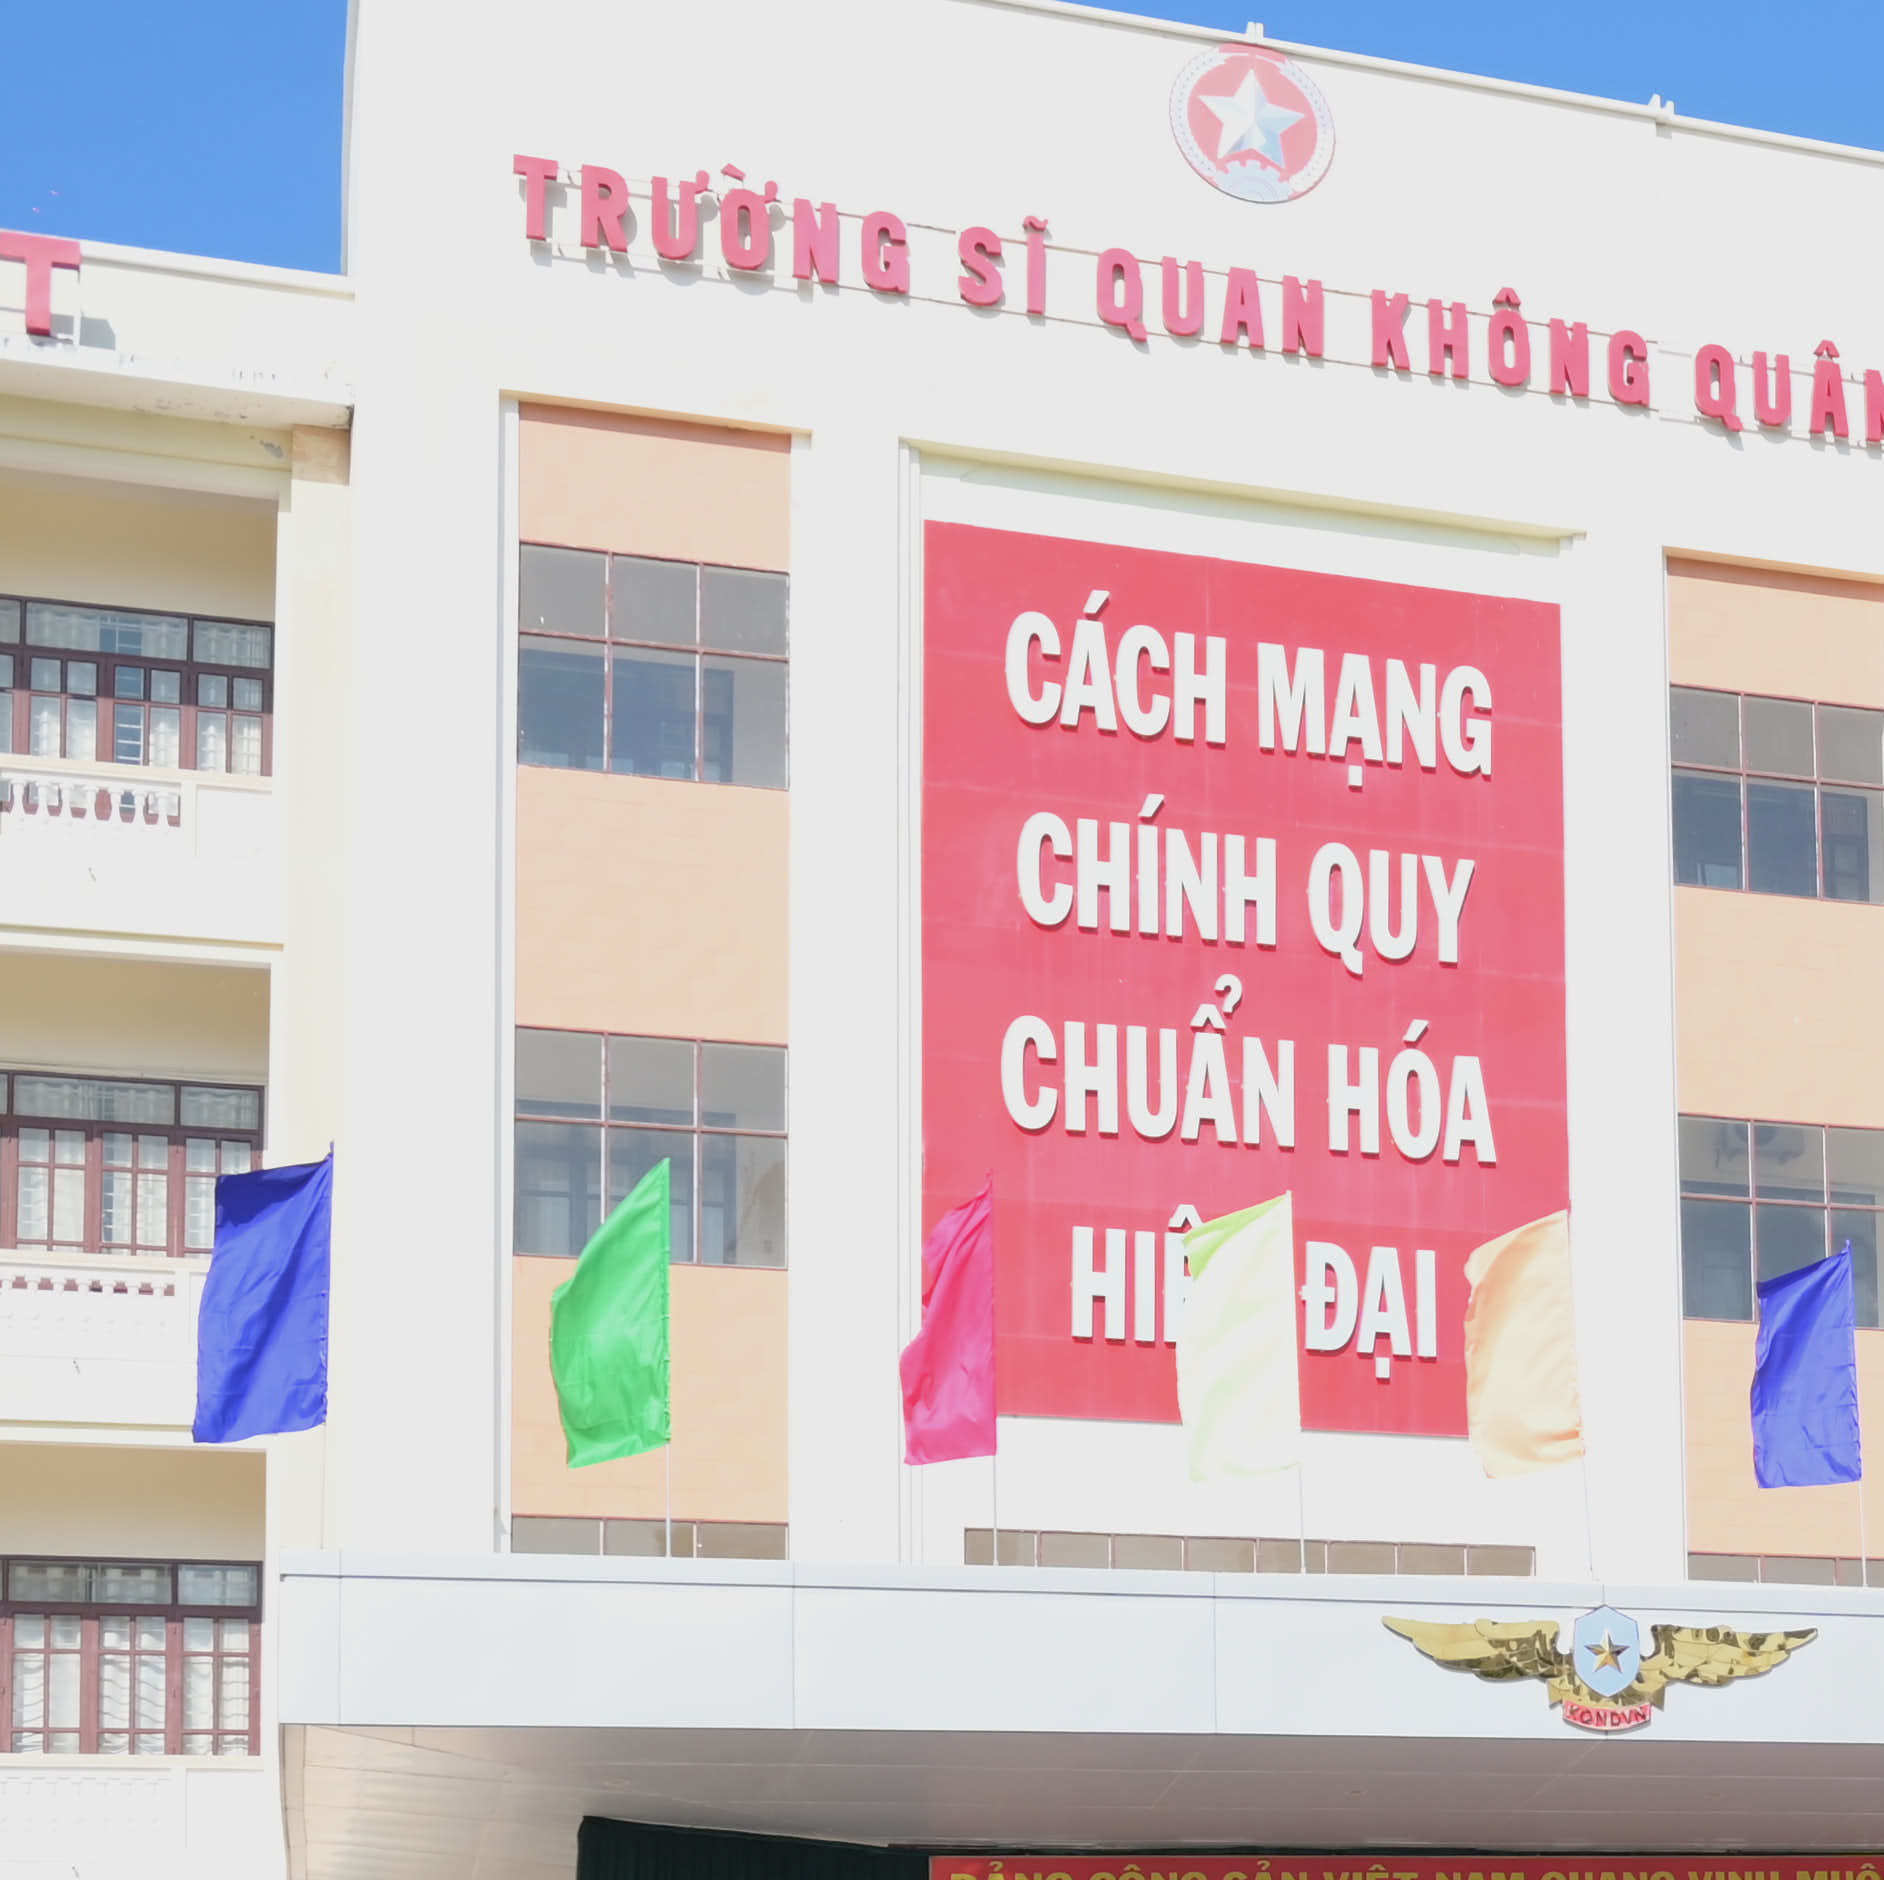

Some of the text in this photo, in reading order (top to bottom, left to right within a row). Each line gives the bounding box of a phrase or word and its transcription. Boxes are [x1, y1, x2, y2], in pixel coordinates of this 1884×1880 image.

[513, 154, 910, 294] TRƯỜNG
[957, 215, 1049, 315] SĨ
[1096, 247, 1324, 358] QUAN
[1371, 286, 1651, 408] KHÔNG
[1005, 589, 1493, 793] CÁCH MẠNG
[1016, 793, 1476, 979] CHÍNH QUY
[1000, 973, 1498, 1171] CHUẨN HÓA
[1299, 1240, 1438, 1384] ĐẠI
